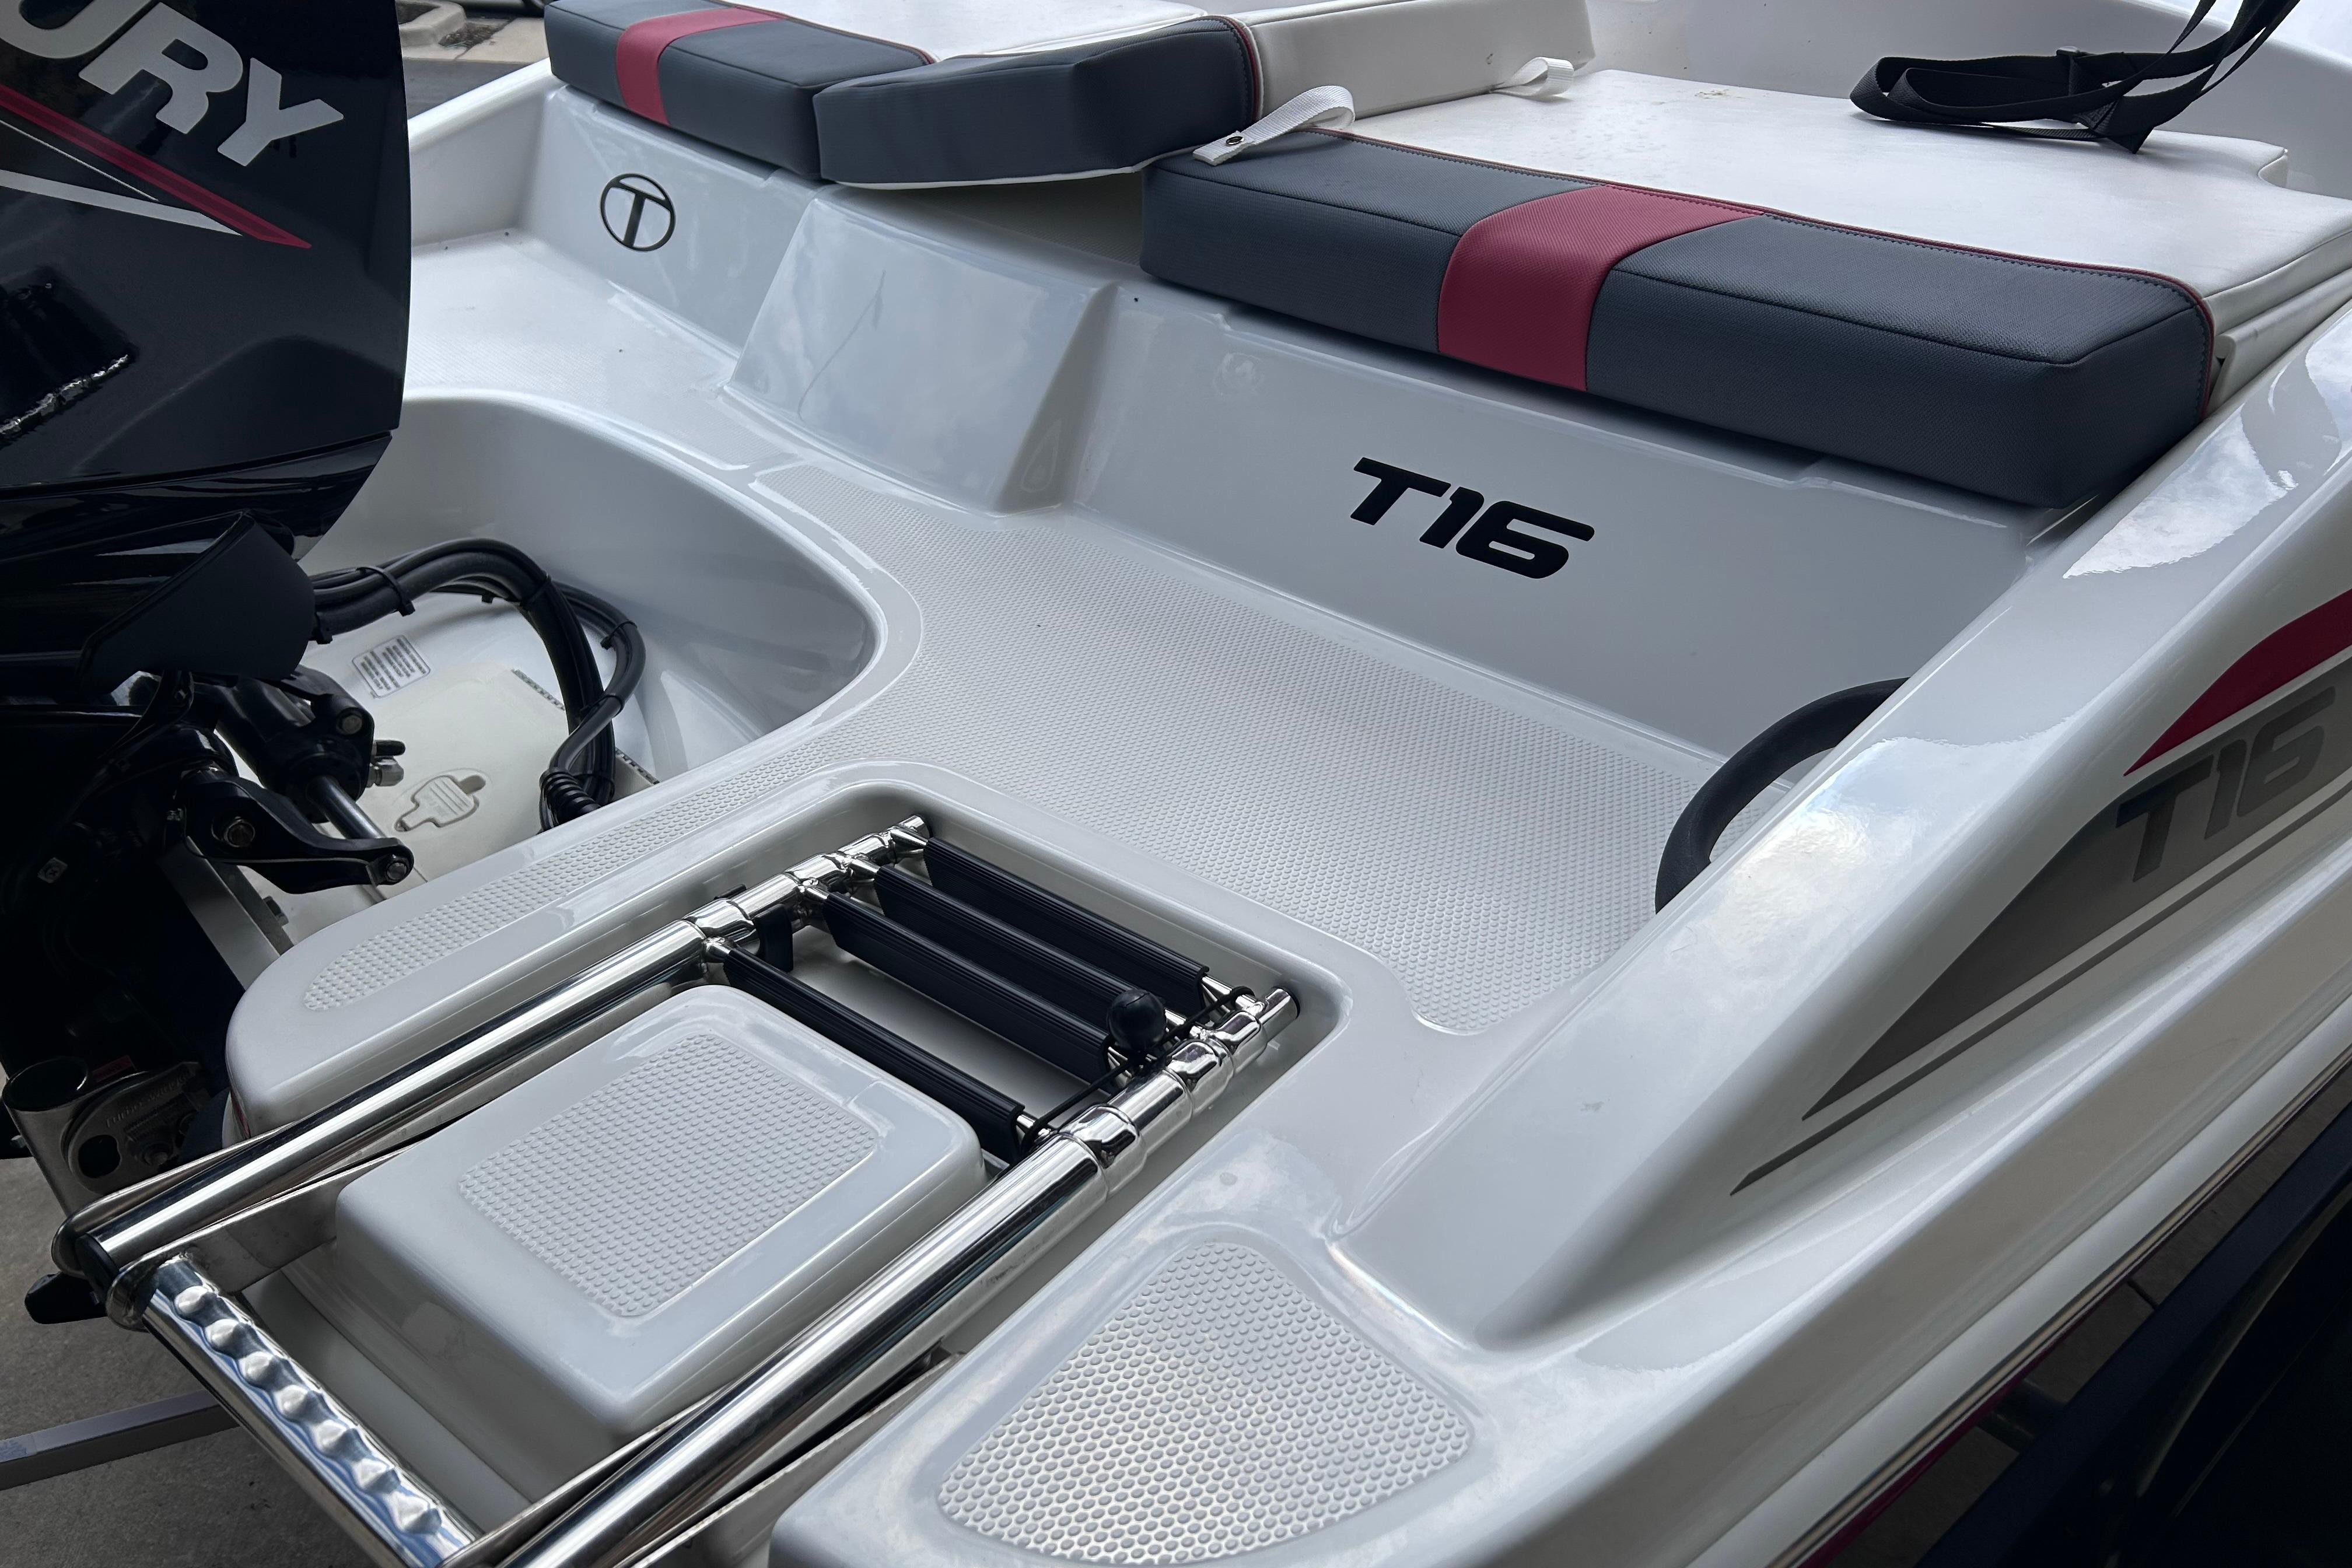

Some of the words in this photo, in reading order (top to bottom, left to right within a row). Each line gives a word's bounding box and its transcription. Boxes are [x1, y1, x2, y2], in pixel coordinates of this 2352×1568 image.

[604, 176, 674, 250] T
[1349, 457, 1595, 579] T16
[2115, 685, 2337, 883] T16
